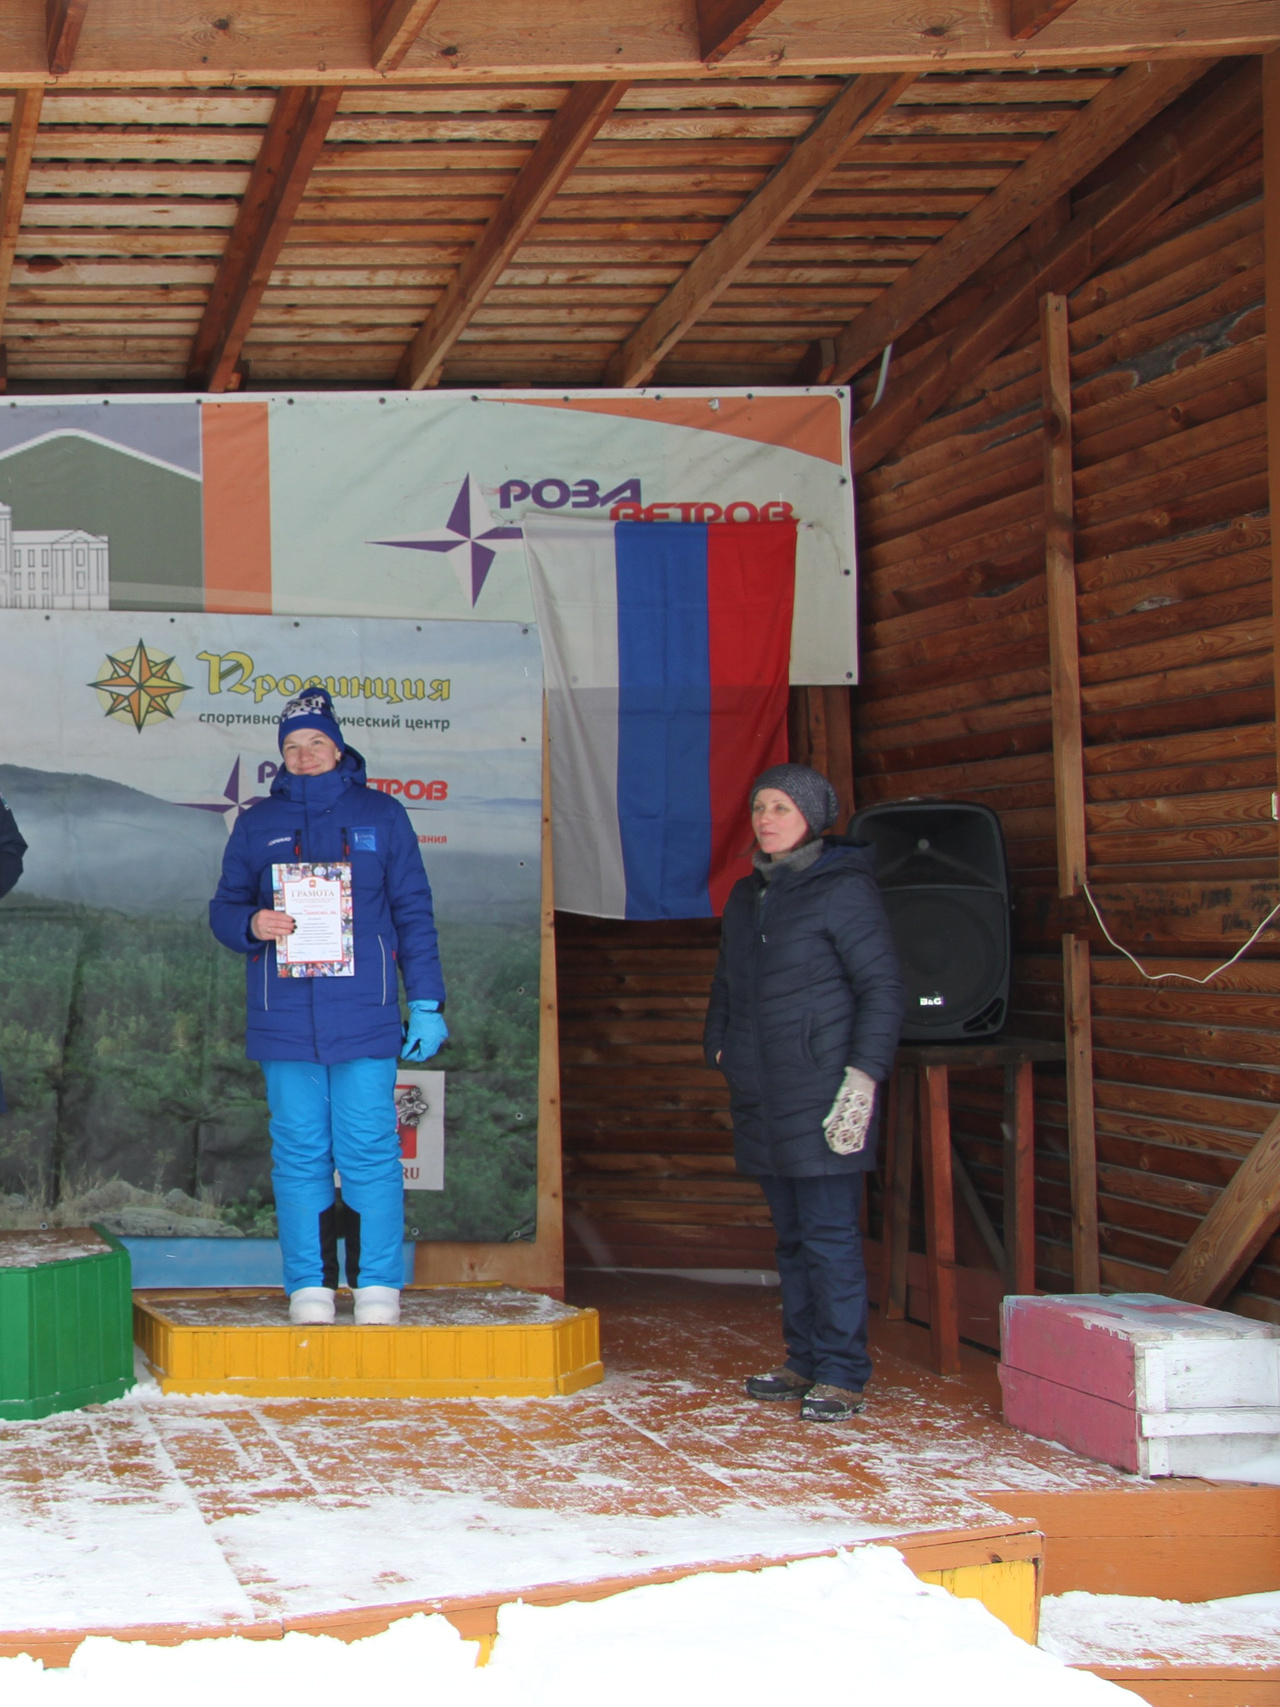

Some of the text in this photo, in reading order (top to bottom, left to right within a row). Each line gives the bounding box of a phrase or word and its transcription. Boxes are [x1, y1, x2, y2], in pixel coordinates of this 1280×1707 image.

[499, 478, 642, 509] РОЗА
[405, 719, 451, 732] центр
[366, 777, 449, 801] ТРОВ
[291, 889, 335, 898] ГРАМОТА
